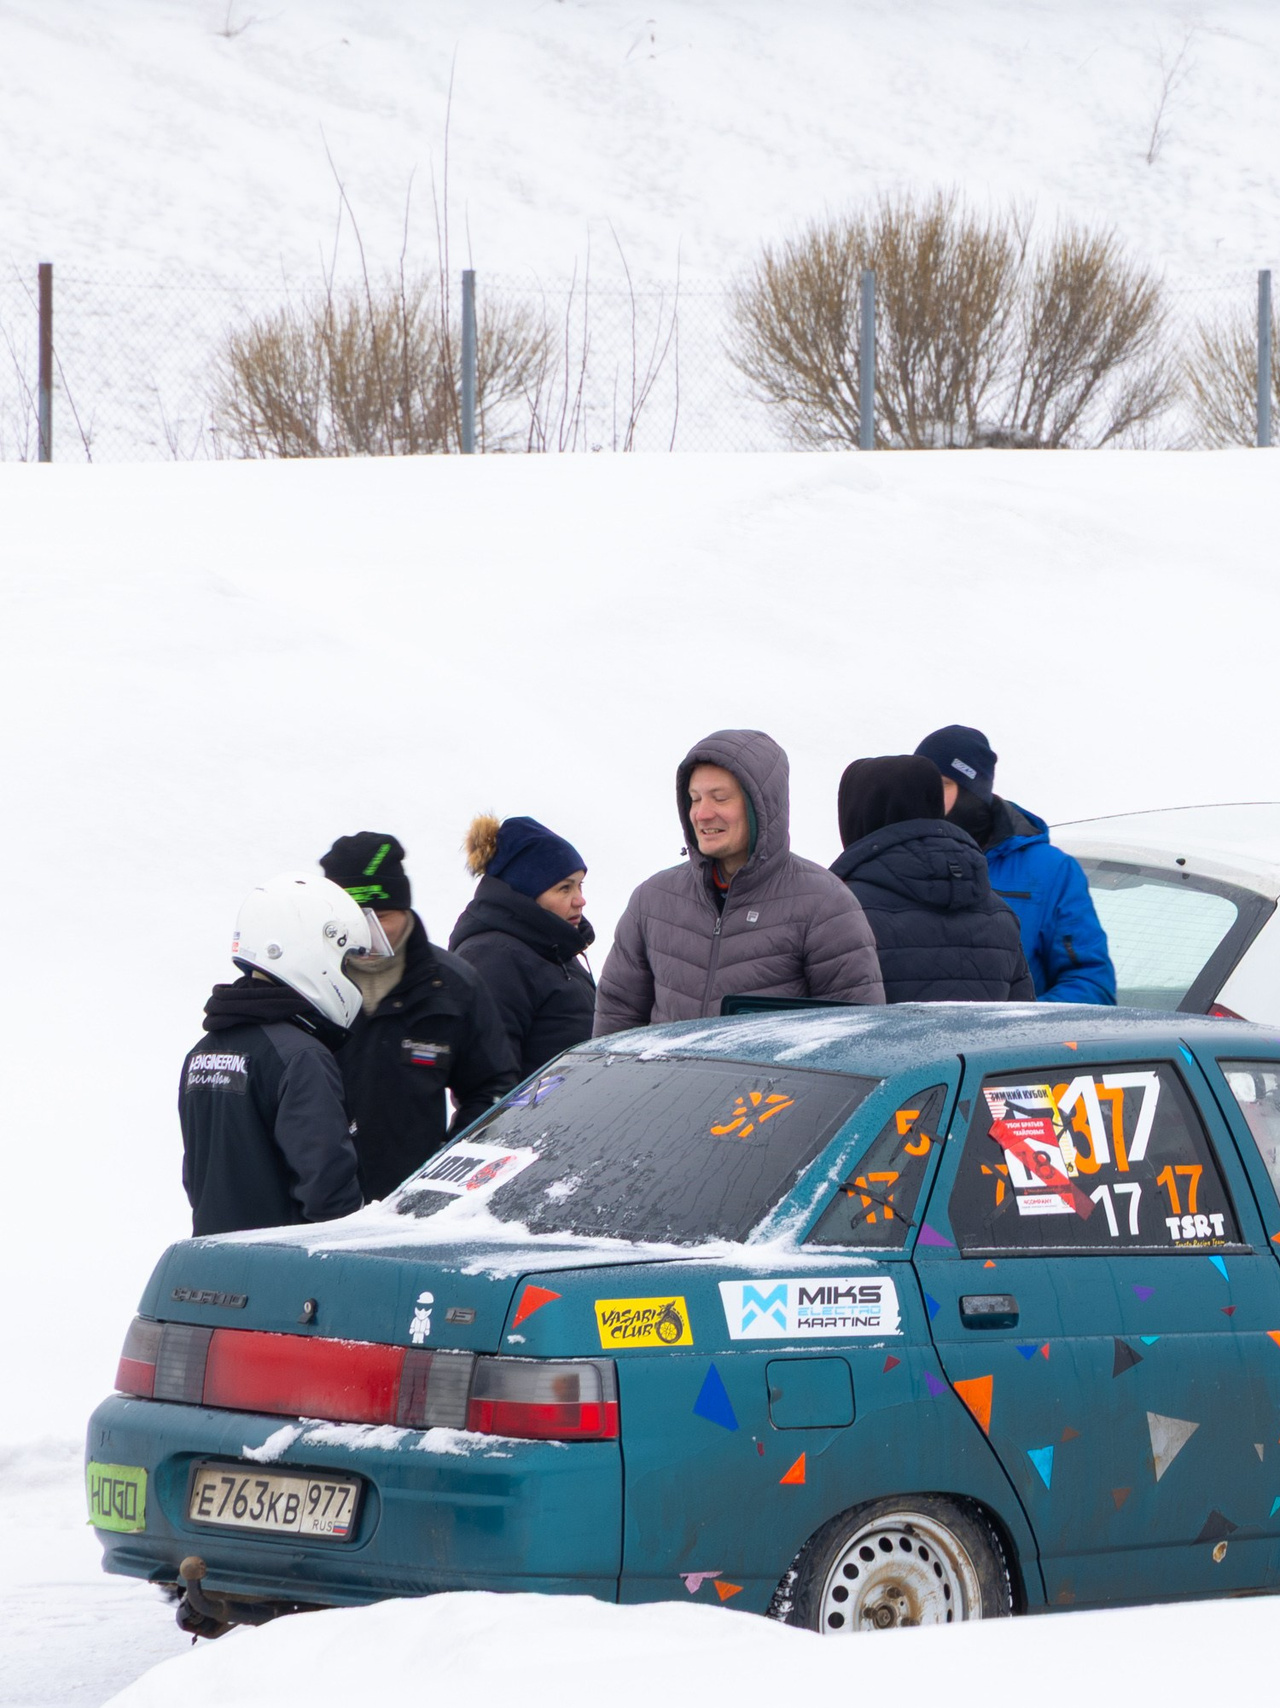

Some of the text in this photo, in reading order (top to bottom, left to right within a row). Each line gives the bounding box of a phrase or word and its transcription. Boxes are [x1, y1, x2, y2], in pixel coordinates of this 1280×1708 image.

[1057, 1071, 1161, 1164] 17
[1156, 1164, 1203, 1214] 17
[1089, 1182, 1142, 1237] 17
[1165, 1213, 1224, 1240] TSRT
[799, 1285, 883, 1306] MIKS
[798, 1304, 881, 1316] ELECTRO
[798, 1316, 880, 1329] KARTING
[610, 1323, 653, 1340] CLUB
[91, 1475, 138, 1521] HOGO
[307, 1483, 351, 1518] 977
[312, 1519, 334, 1532] RUS
